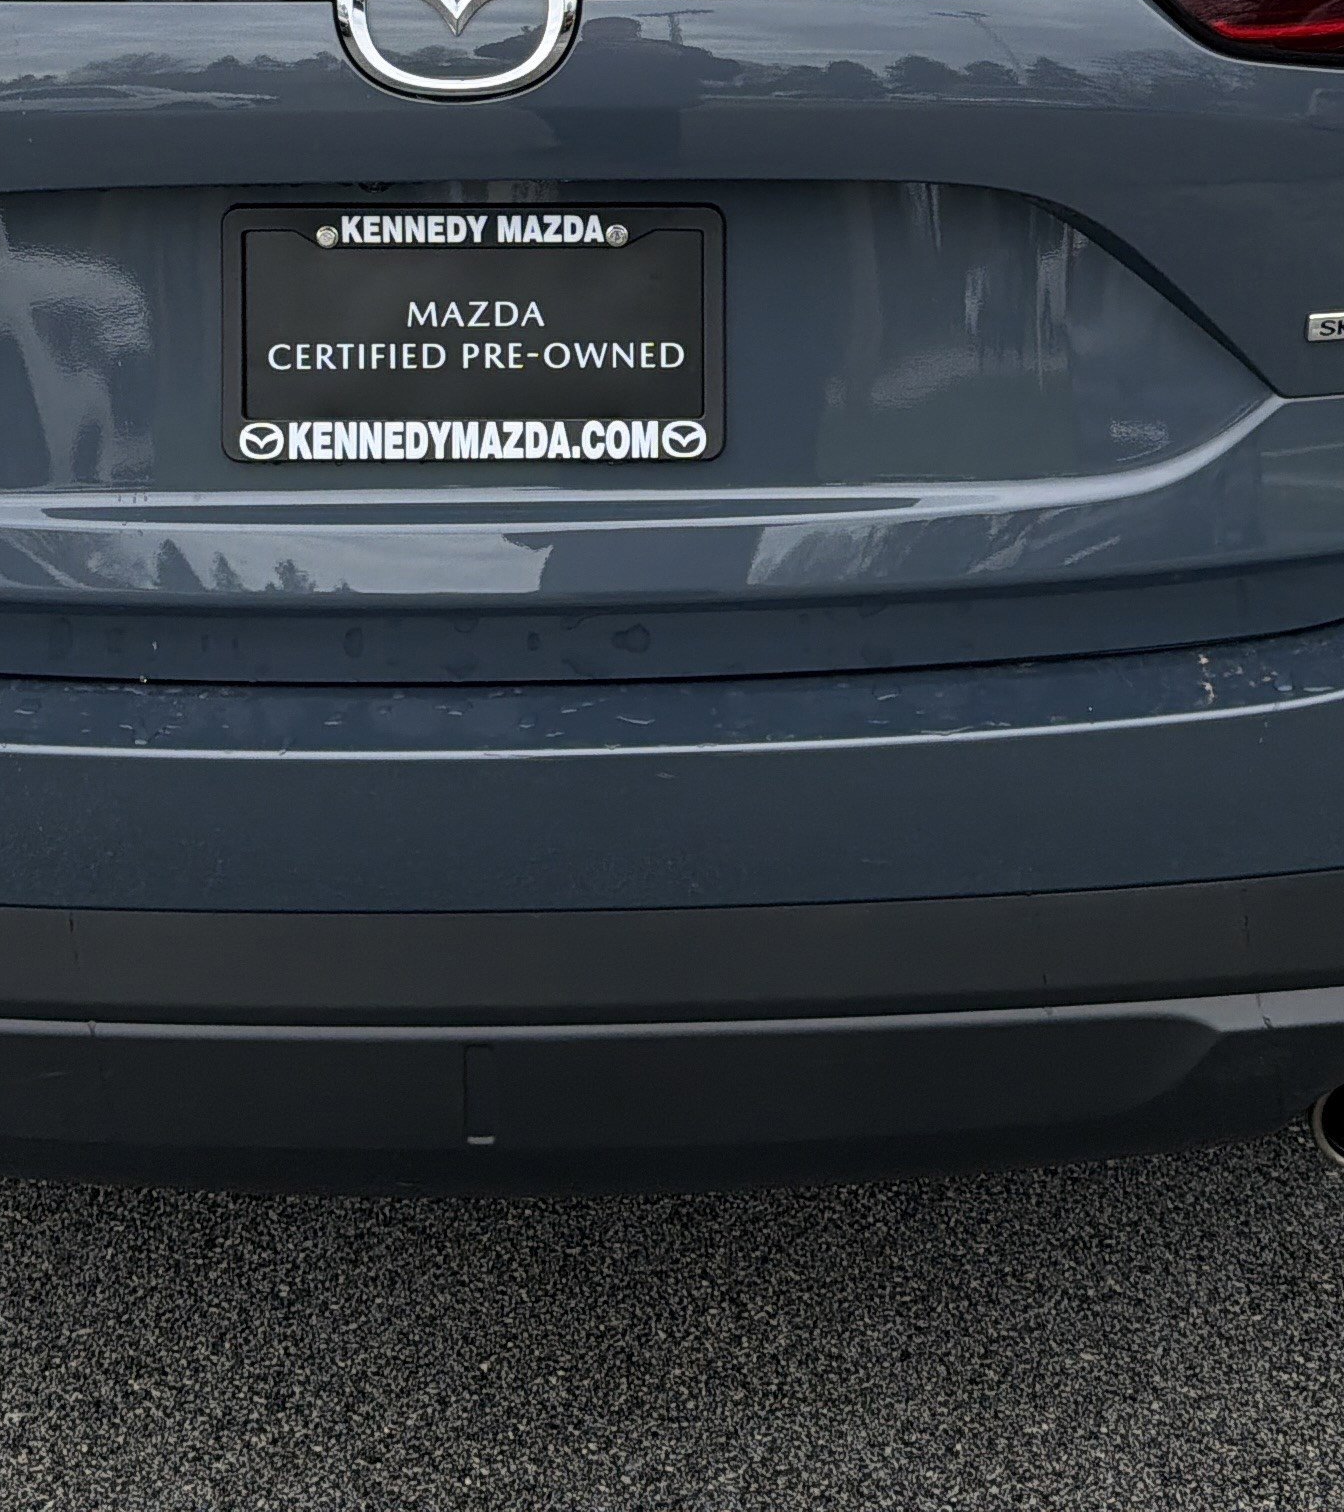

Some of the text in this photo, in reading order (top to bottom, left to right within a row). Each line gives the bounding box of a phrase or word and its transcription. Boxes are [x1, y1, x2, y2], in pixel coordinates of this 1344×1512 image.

[341, 214, 605, 244] KENNEDY MAZDA
[406, 301, 545, 328] MAZDA
[267, 341, 685, 370] CERTIFIED PRE-OWNED
[288, 420, 659, 460] KENNEDYMAZDA.COM
